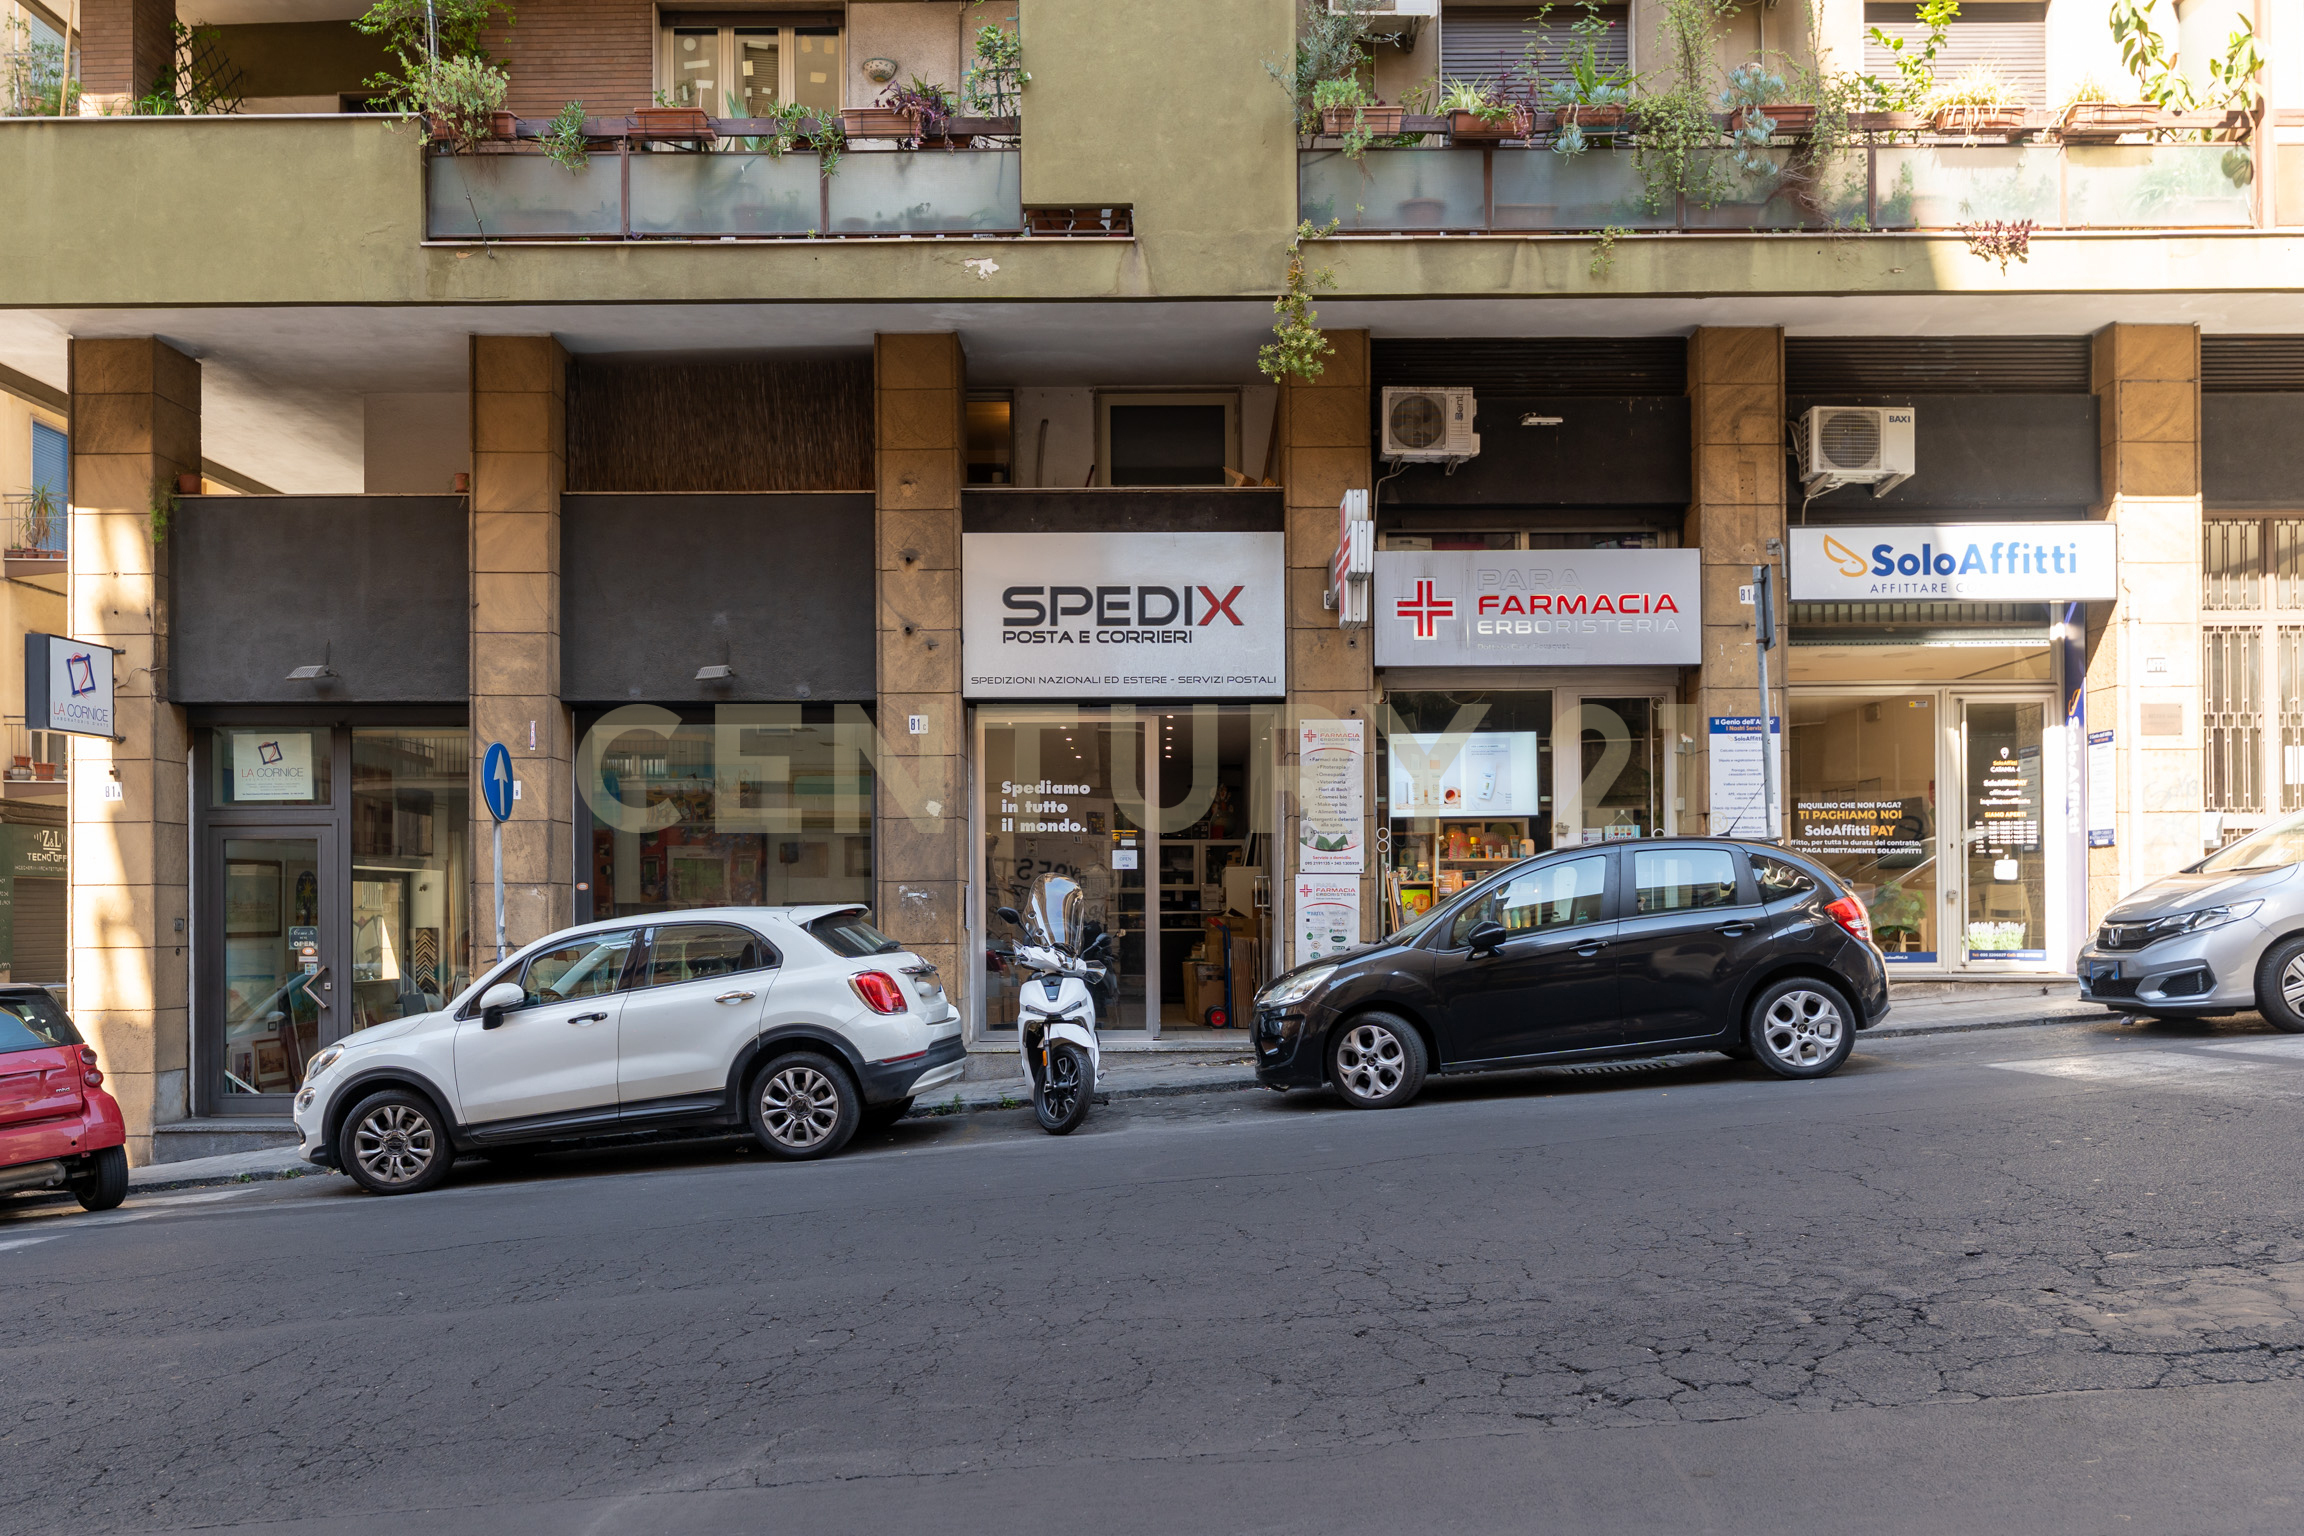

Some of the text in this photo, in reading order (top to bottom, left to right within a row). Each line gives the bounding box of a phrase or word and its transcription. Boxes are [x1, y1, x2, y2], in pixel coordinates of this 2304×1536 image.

[1889, 415, 1911, 423] BAXI
[1871, 542, 2077, 576] SoloAffitti
[1477, 568, 1583, 591] PARA
[1870, 583, 1947, 593] AFFITTARE
[1002, 585, 1245, 626] SPEDIX
[1478, 593, 1679, 615] FARMACIA
[1477, 619, 1680, 634] ERBORISTERIA
[1003, 631, 1192, 644] POSTA E CORRIERI
[971, 676, 1035, 685] SPEDIZIONI
[1038, 676, 1101, 685] NAZIONALI
[1104, 676, 1120, 685] ED
[1123, 676, 1167, 685] ESTERE
[1178, 676, 1224, 685] SERVIZI
[1227, 676, 1277, 685] POSTALI
[53, 701, 109, 723] LA CORNICE
[241, 767, 304, 778] LA CORNICE
[1001, 781, 1091, 798] Spediamo
[1002, 800, 1068, 813] in tutto
[1798, 810, 1902, 820] TI PAGHIAMO NOI
[1002, 818, 1087, 832] il mondo.
[43, 830, 61, 848] Z&L
[1790, 839, 1810, 847] ffitto,
[1886, 839, 1922, 847] contratto,
[27, 852, 51, 862] TECNO
